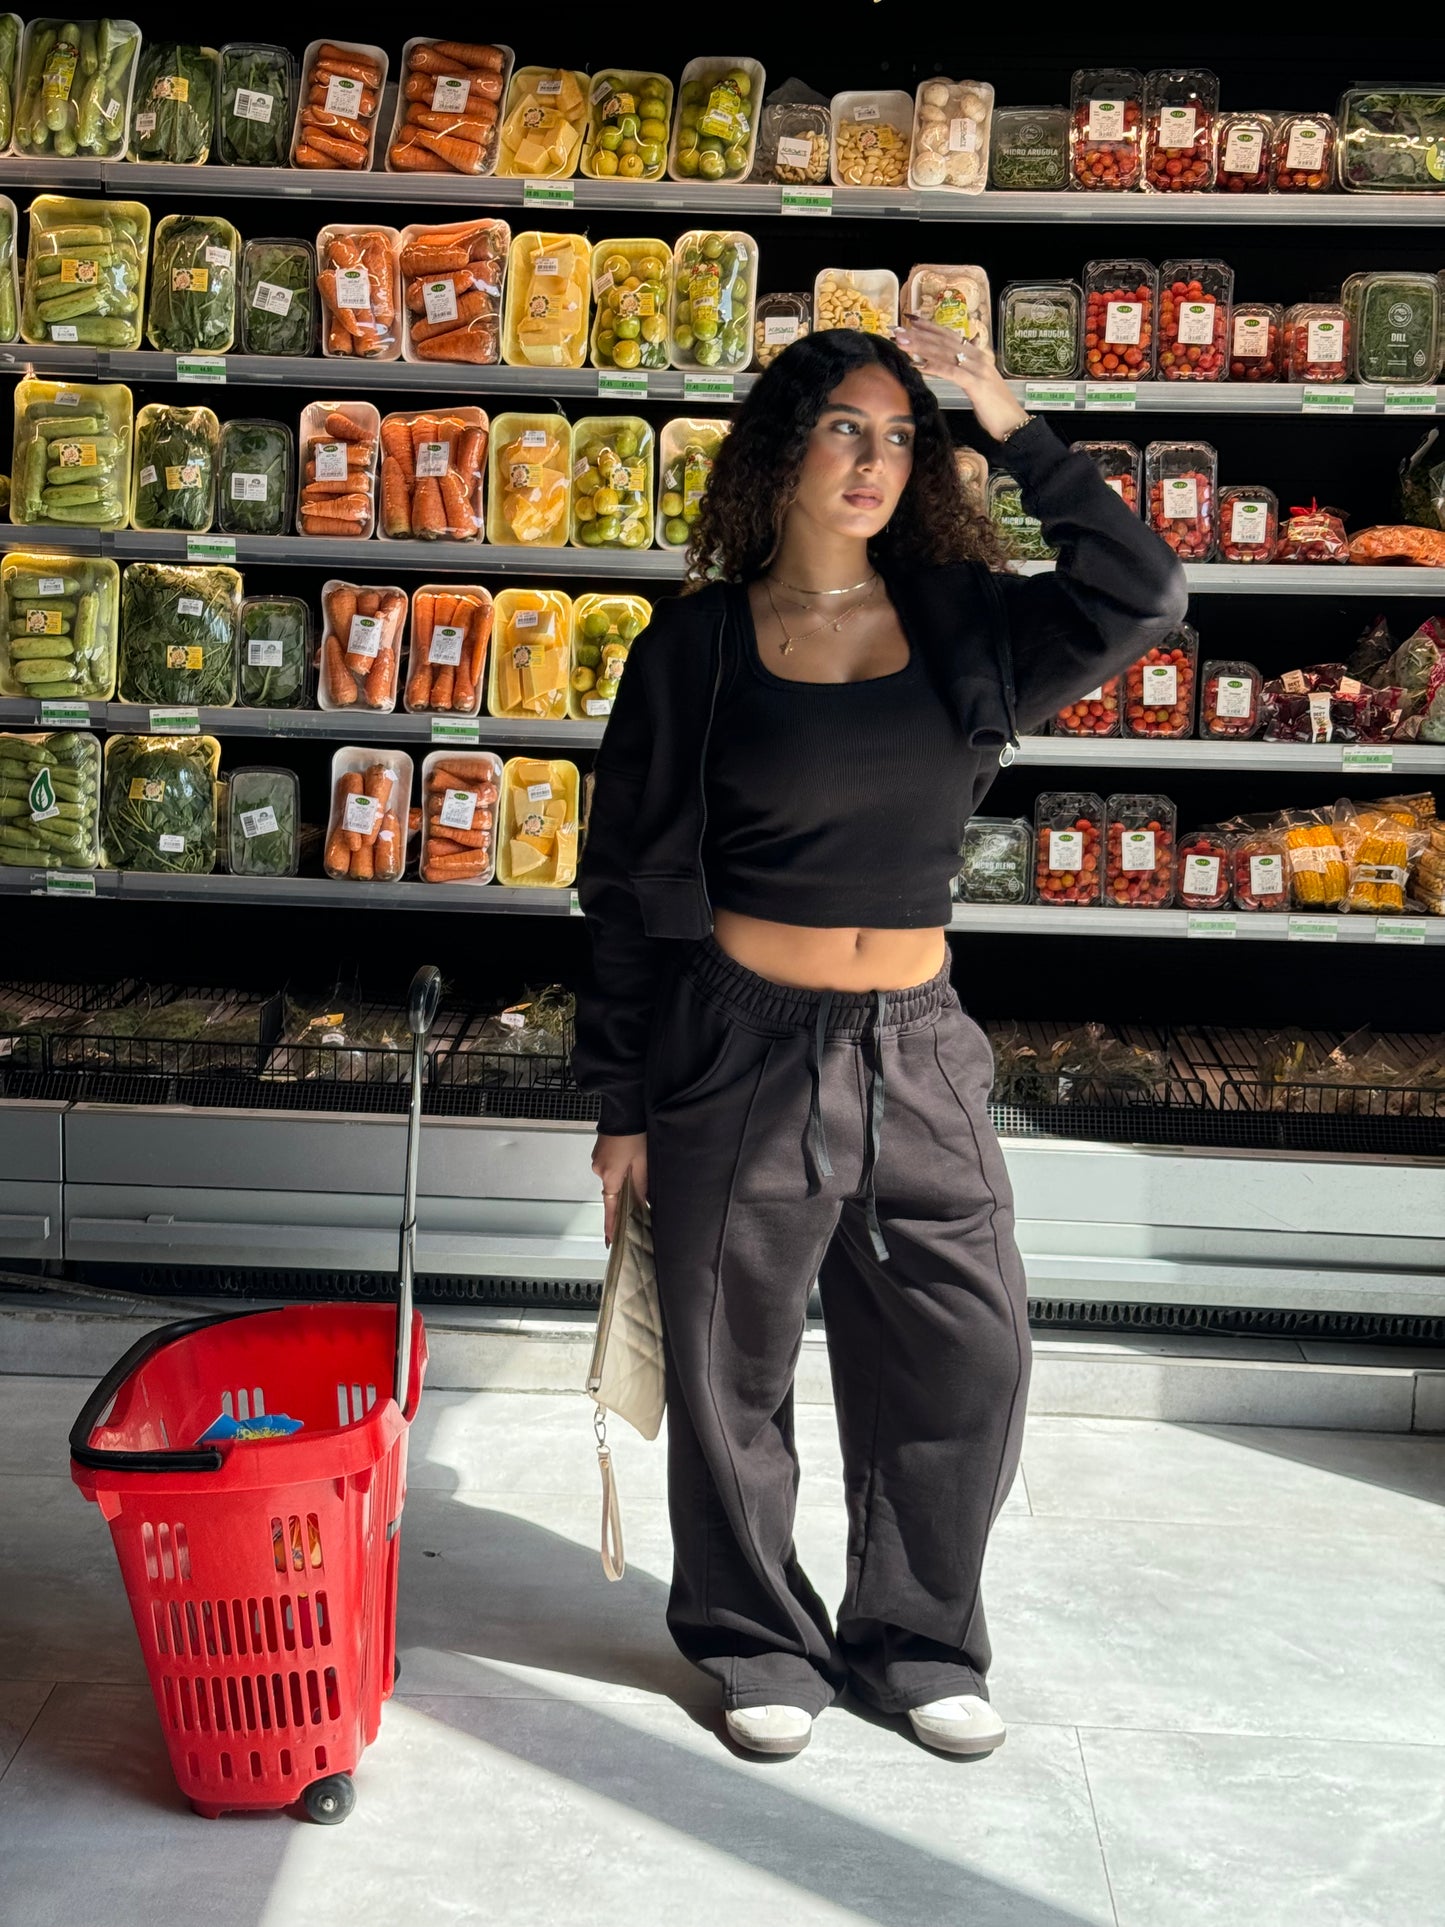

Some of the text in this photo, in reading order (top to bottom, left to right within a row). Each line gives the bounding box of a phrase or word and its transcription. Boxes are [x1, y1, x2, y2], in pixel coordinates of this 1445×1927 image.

[1003, 148, 1059, 156] MICRO ARUGULA
[1014, 329, 1070, 338] MICRO ARUGULA
[1391, 333, 1407, 342] DILL
[1001, 516, 1025, 525] MICRO
[995, 862, 1016, 870] BLEND
